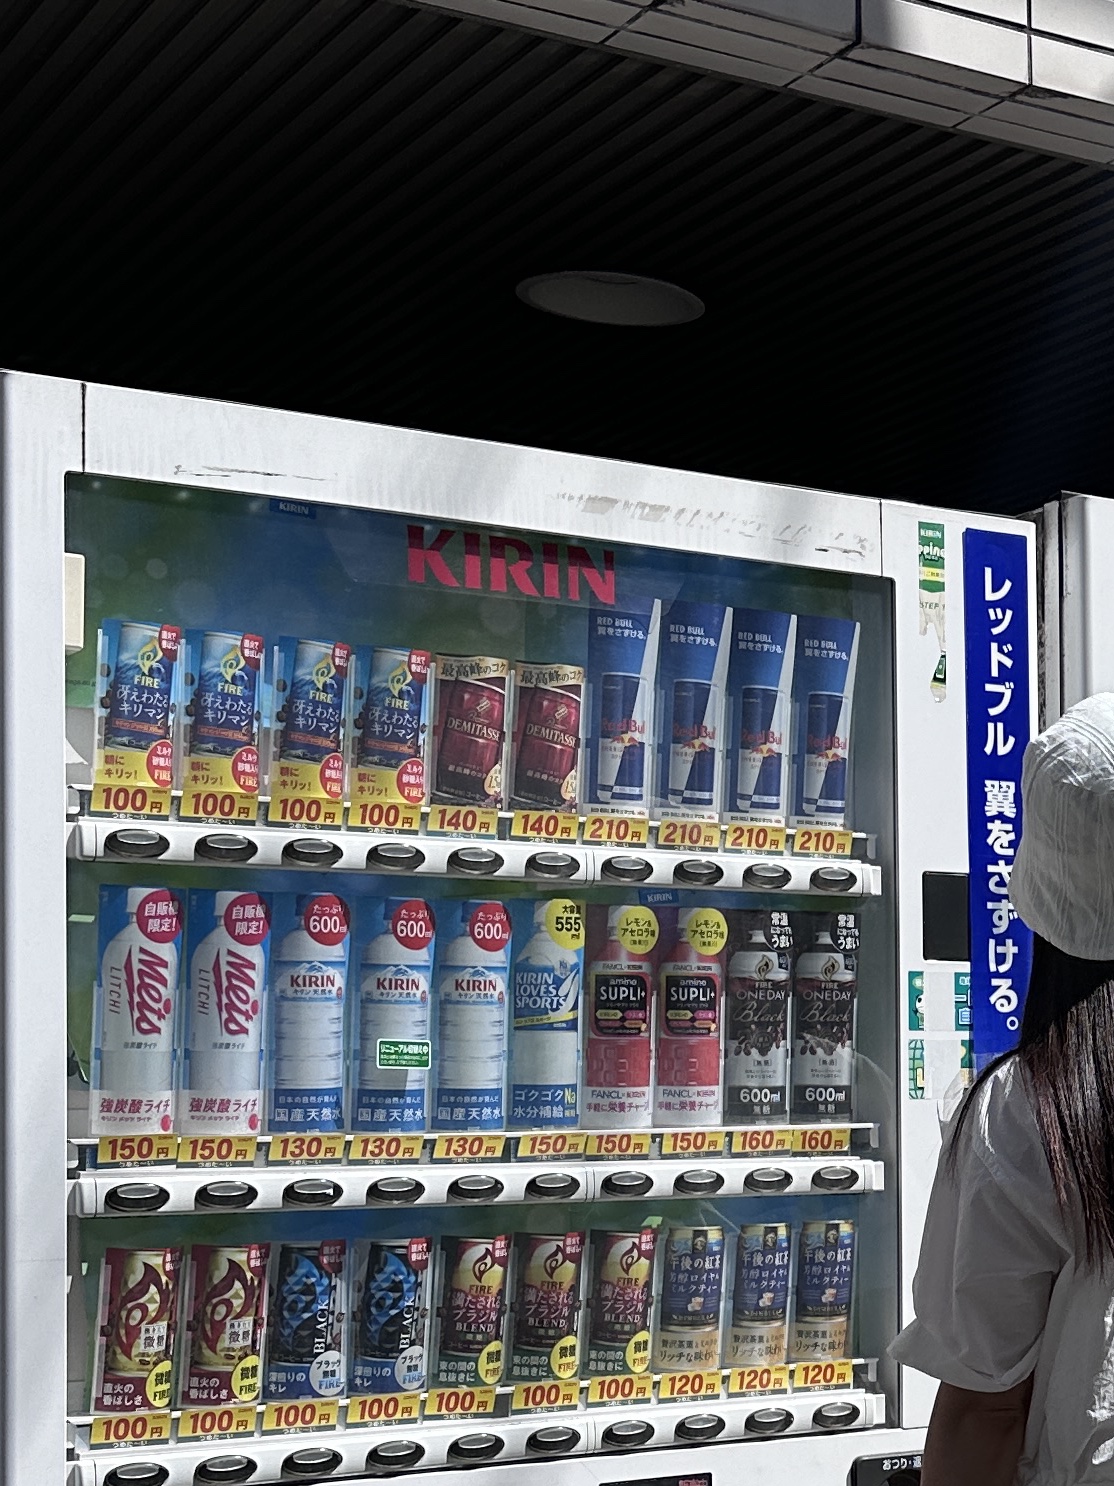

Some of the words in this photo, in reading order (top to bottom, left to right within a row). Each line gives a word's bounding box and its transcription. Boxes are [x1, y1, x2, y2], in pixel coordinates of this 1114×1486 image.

[407, 525, 616, 605] KIRIN
[597, 616, 612, 627] RED
[670, 624, 685, 635] RED
[440, 660, 507, 677] 最高峰のコク
[983, 567, 1015, 756] レッドブル
[134, 675, 160, 689] FIRE
[521, 667, 583, 683] 最高峰のコク
[218, 683, 243, 697] FIRE
[309, 690, 337, 704] FIRE
[384, 696, 410, 711] FIRE
[118, 703, 165, 722] キリマン
[204, 710, 250, 728] キリマン
[294, 715, 339, 734] キリマン
[102, 787, 163, 813] 100円
[192, 792, 250, 818] 100円
[279, 798, 337, 826] 100円
[358, 803, 414, 829] 100円
[438, 808, 490, 833] 140円
[521, 814, 572, 838] 140円
[589, 818, 641, 842] 210円
[663, 823, 714, 847] 210円
[731, 827, 779, 850] 210円
[799, 831, 846, 853] 210円
[646, 893, 673, 903] KIRIN
[144, 901, 178, 916] 自販機
[232, 903, 267, 920] 自販機
[562, 904, 582, 915] 大容量
[148, 917, 177, 934] 限定!
[555, 917, 581, 932] 555
[770, 912, 789, 926] 常温
[235, 920, 265, 935] 限定!
[772, 935, 793, 949] うまい
[290, 974, 336, 988] KIRIN
[376, 978, 420, 992] KIRIN
[609, 977, 639, 987] amino
[109, 966, 122, 1015] LITCHI
[135, 945, 172, 1035] Mets
[197, 968, 211, 1016] LITCHI
[224, 947, 260, 1037] Mets
[516, 984, 557, 997] LOVES
[515, 996, 567, 1010] SPORTS
[733, 1000, 786, 1023] Black
[800, 1000, 851, 1023] Black
[514, 1090, 561, 1101] ゴクゴク
[740, 1088, 781, 1103] 600ml
[100, 1097, 171, 1114] 強炭酸ライチ
[189, 1097, 259, 1114] 強炭酸ライチ
[513, 1105, 564, 1118] 水分補給
[752, 1104, 771, 1115] 無糖
[275, 1107, 342, 1122] 国産天然水
[358, 1107, 423, 1122] 国産天然水
[438, 1107, 502, 1121] 国産天然水
[108, 1136, 169, 1160] 150円
[280, 1137, 336, 1159] 130円
[361, 1137, 414, 1158] 130円
[444, 1136, 496, 1157] 130円
[531, 1135, 581, 1154] 150円
[597, 1135, 646, 1154] 150円
[740, 1130, 785, 1150] 160円
[800, 1130, 844, 1150] 160円
[189, 1138, 248, 1160] 150円
[526, 1305, 571, 1317] ブラジル
[602, 1300, 645, 1313] ブラジル
[399, 1295, 415, 1350] BLACK
[453, 1309, 497, 1322] ブラジル
[528, 1318, 566, 1327] BLEND
[603, 1313, 640, 1322] BLEND
[313, 1300, 329, 1354] BLACK
[455, 1322, 494, 1332] BLEND
[316, 1359, 341, 1370] ブラック
[401, 1352, 423, 1364] ブラック
[268, 1371, 306, 1382] 深煎りの
[354, 1365, 391, 1377] 深煎りの
[737, 1368, 783, 1390] 120円
[802, 1363, 846, 1385] 120円
[103, 1383, 134, 1394] 直火の
[190, 1376, 220, 1388] 直火の
[268, 1383, 286, 1393] キレ
[354, 1377, 372, 1387] キレ
[668, 1373, 715, 1395] 120円
[102, 1394, 143, 1406] 香ばしさ
[189, 1388, 229, 1399] 香ばしさ
[102, 1416, 163, 1441] 100円
